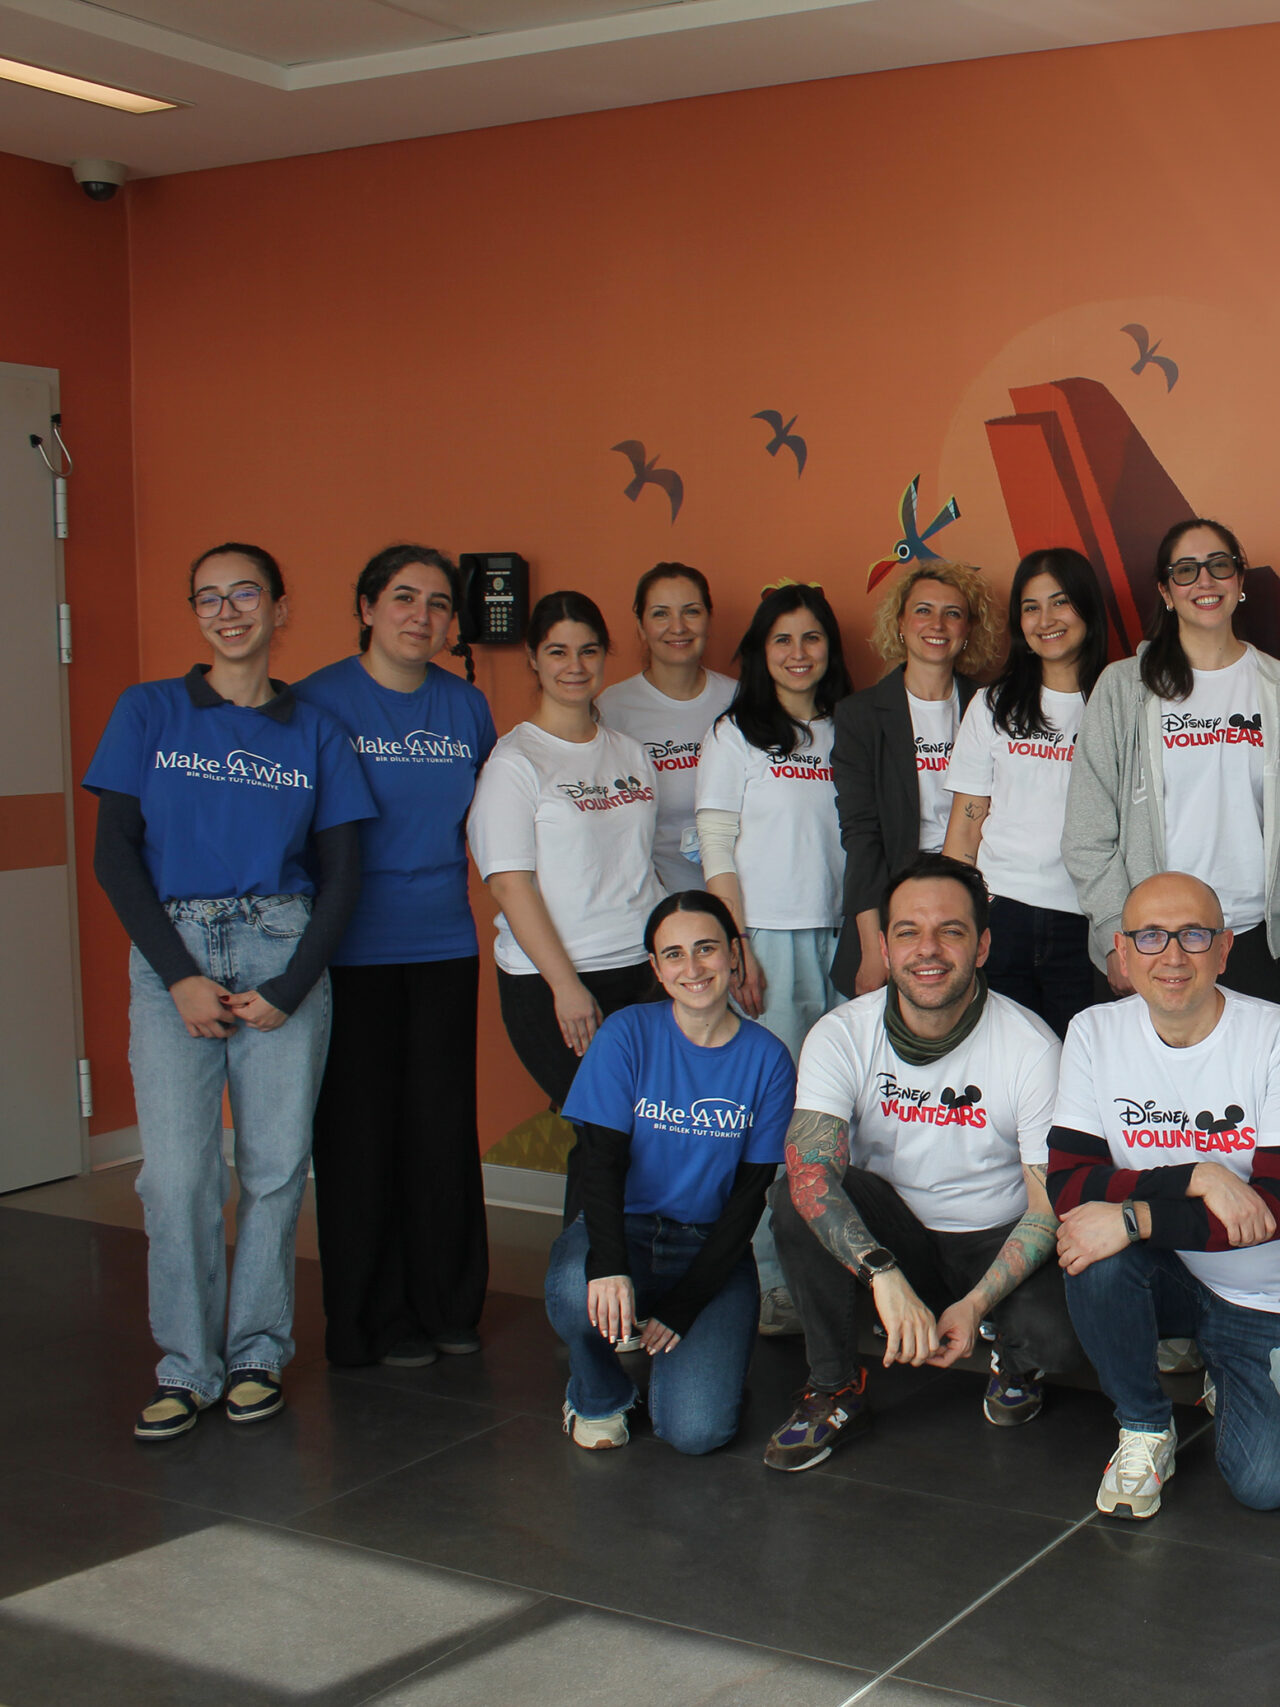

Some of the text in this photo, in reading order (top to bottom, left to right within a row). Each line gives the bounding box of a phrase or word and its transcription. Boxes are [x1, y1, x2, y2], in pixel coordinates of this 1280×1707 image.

[1161, 713, 1222, 733] Disney
[913, 736, 953, 758] isney
[1162, 727, 1264, 749] VOLUNTEAR
[1007, 741, 1075, 762] VOLUNTE
[154, 750, 310, 789] Make-A-Wish
[652, 755, 701, 772] VOLUN
[769, 765, 834, 782] VOLUNT
[573, 787, 655, 812] VOLUNTEARS
[634, 1097, 754, 1130] Make-A-Wi
[881, 1098, 987, 1129] VUNTEARS
[1113, 1098, 1190, 1132] Disney
